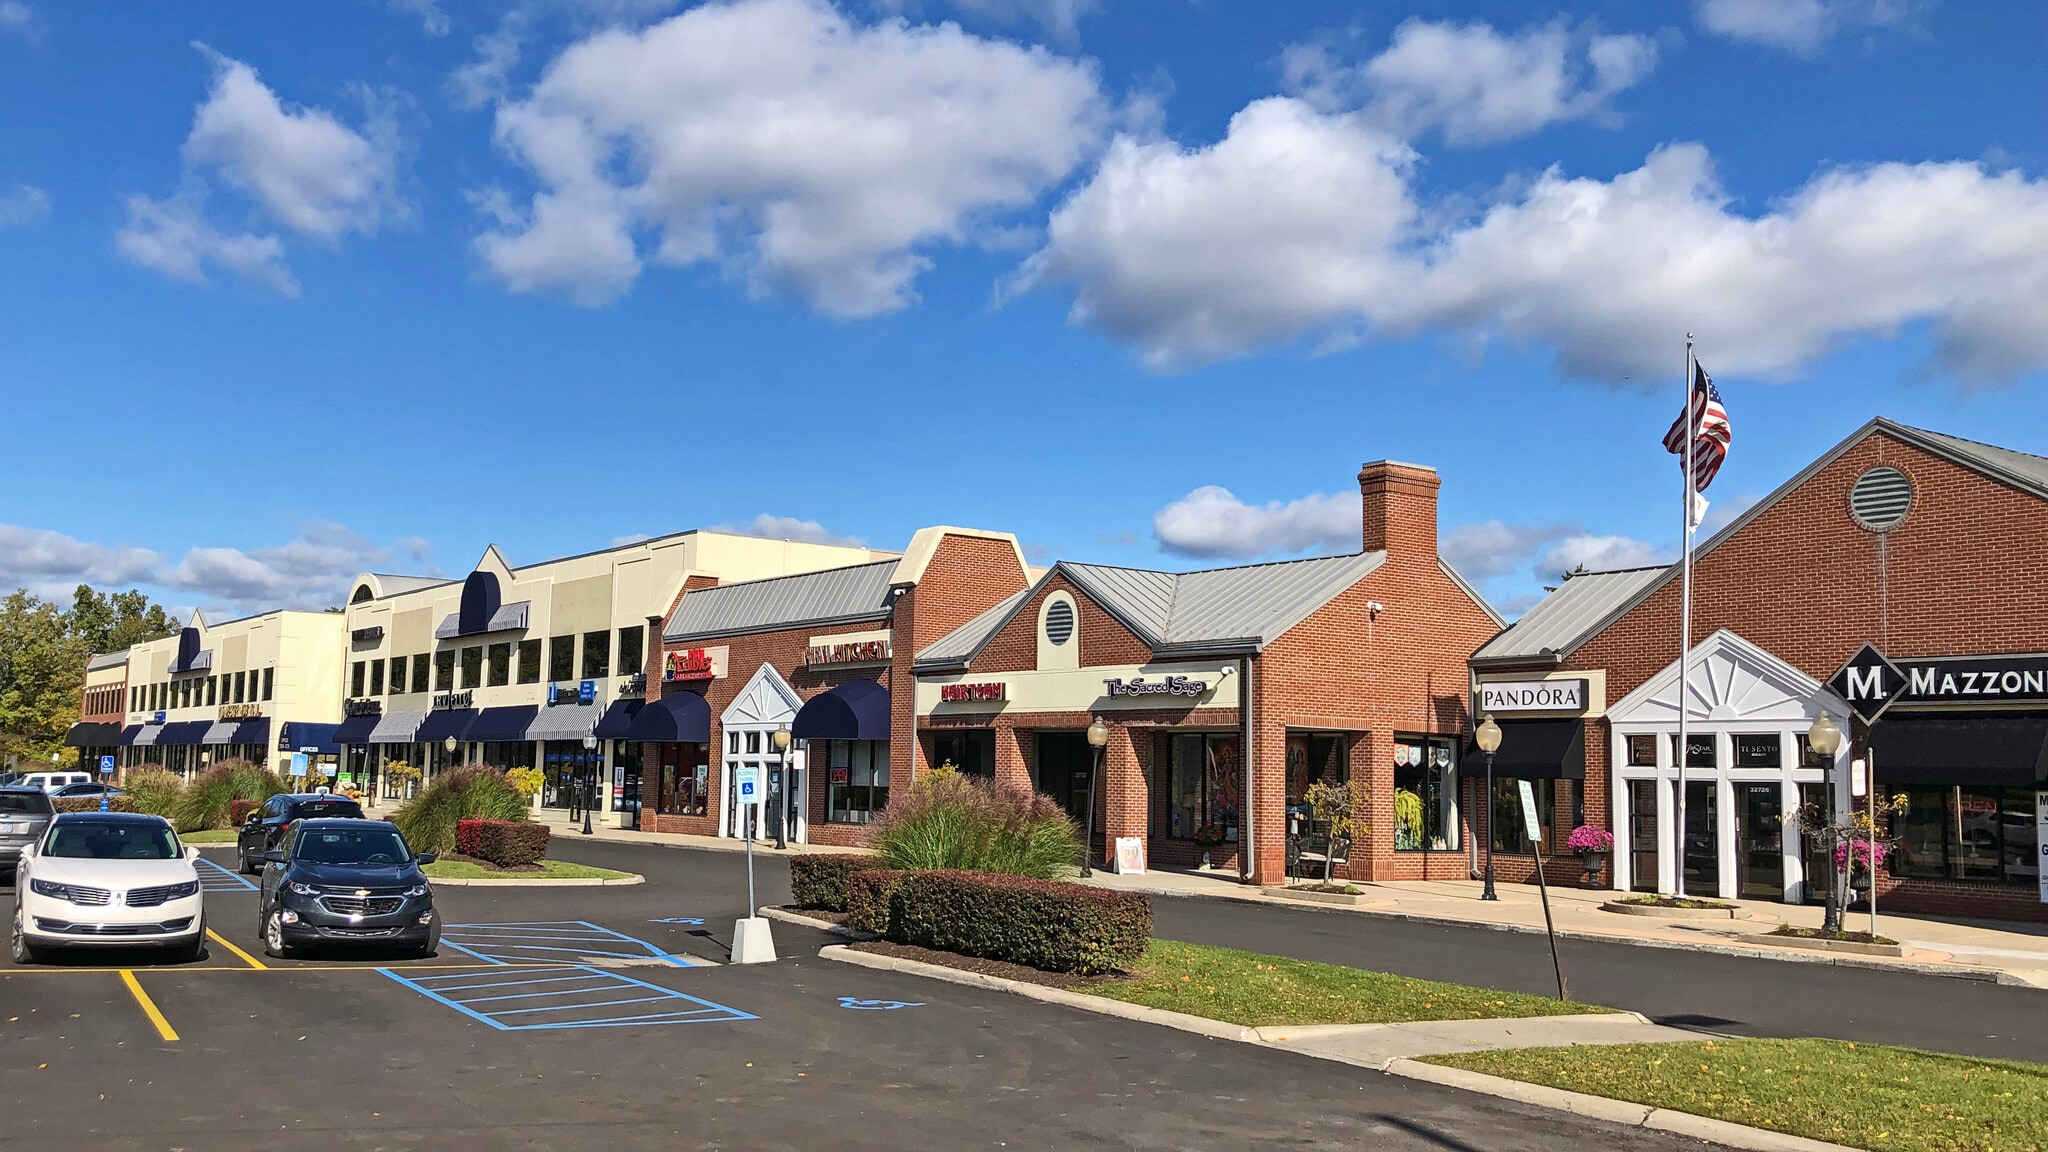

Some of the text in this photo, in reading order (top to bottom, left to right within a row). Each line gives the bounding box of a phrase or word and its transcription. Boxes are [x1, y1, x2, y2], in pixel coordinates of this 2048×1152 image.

[673, 648, 713, 671] Edible
[834, 640, 887, 662] KITCHEN
[1103, 676, 1204, 697] The Sacred Sage
[1910, 666, 2048, 696] MAZZON
[941, 682, 1003, 702] HAIR TEAM
[1484, 688, 1577, 706] PANDORA
[1751, 745, 1778, 753] SENTO
